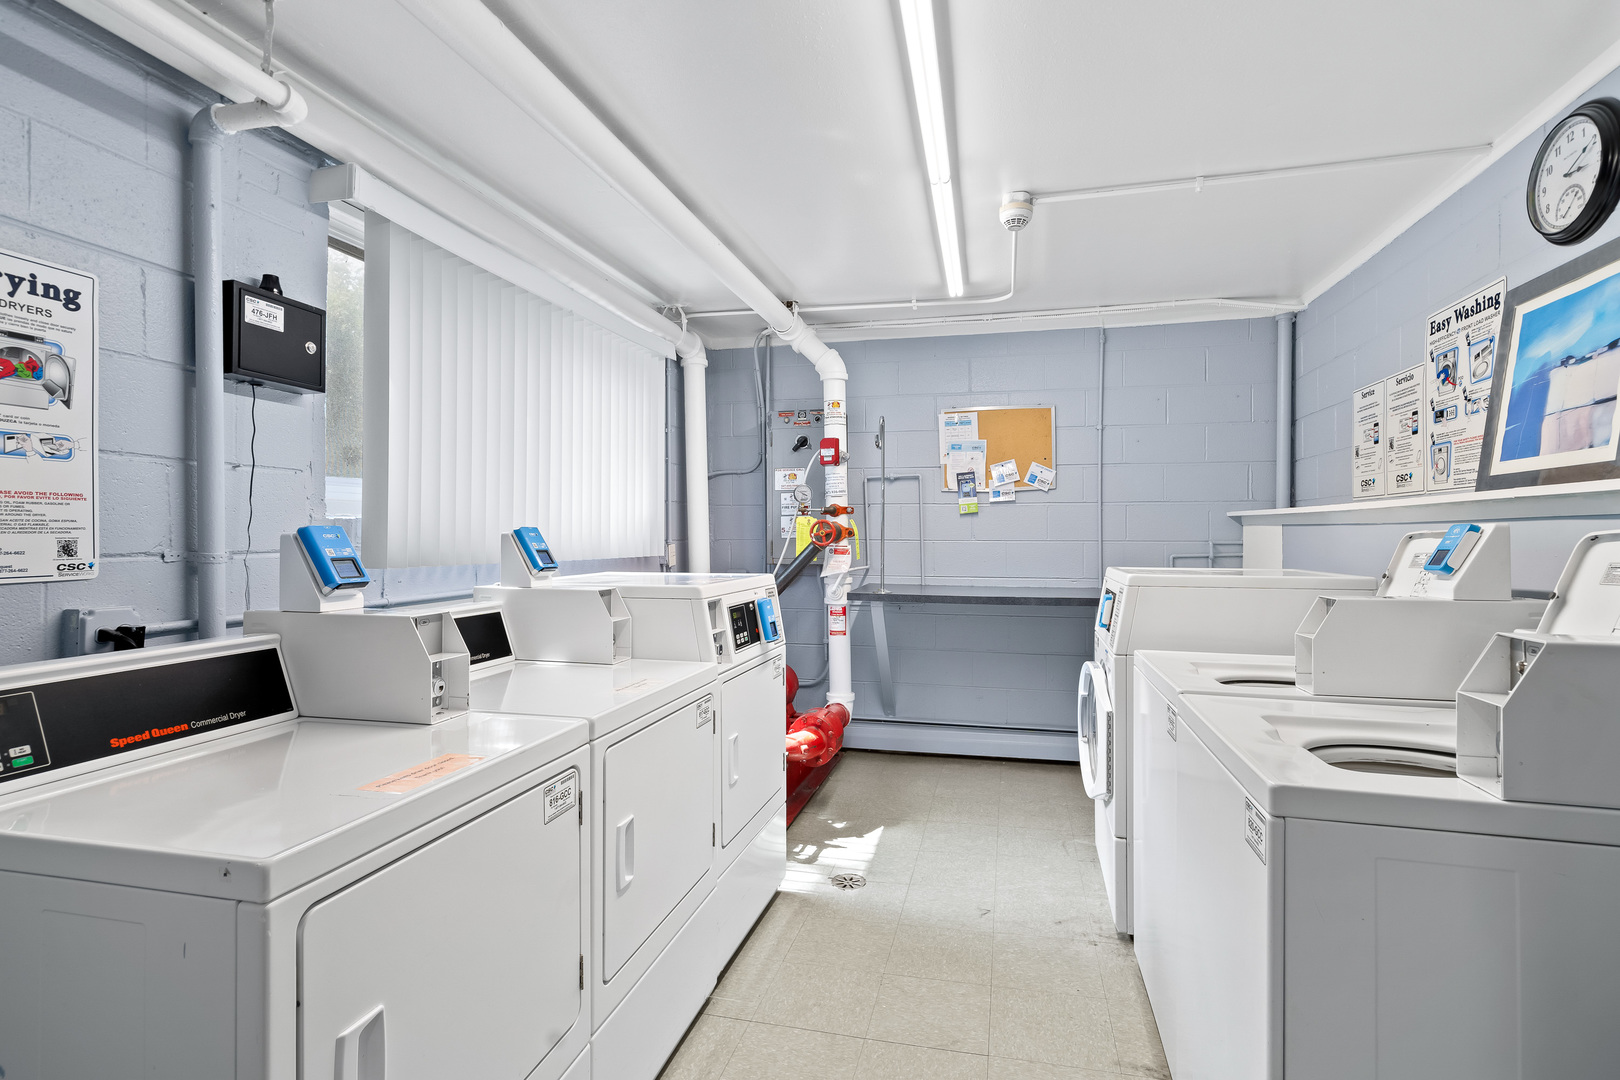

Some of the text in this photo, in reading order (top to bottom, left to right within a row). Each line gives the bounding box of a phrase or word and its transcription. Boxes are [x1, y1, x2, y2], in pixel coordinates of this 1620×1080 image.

[1566, 131, 1574, 144] 12
[1582, 127, 1586, 137] 1
[1555, 145, 1561, 157] 11
[1546, 165, 1553, 176] 10
[1542, 187, 1547, 197] 9
[1545, 204, 1550, 214] 8
[0, 272, 82, 312] ying
[1430, 316, 1452, 336] Easy
[1454, 292, 1501, 323] Washing
[1461, 322, 1473, 331] FRONT
[1474, 316, 1484, 326] LOAD
[1484, 310, 1501, 321] WASHER
[1396, 373, 1414, 386] Servicio
[1361, 389, 1375, 399] Service
[1361, 479, 1372, 487] CSC
[1396, 474, 1408, 483] CSC
[57, 563, 86, 571] CSC
[110, 710, 247, 748] Speed Queen Commercial Dryer
